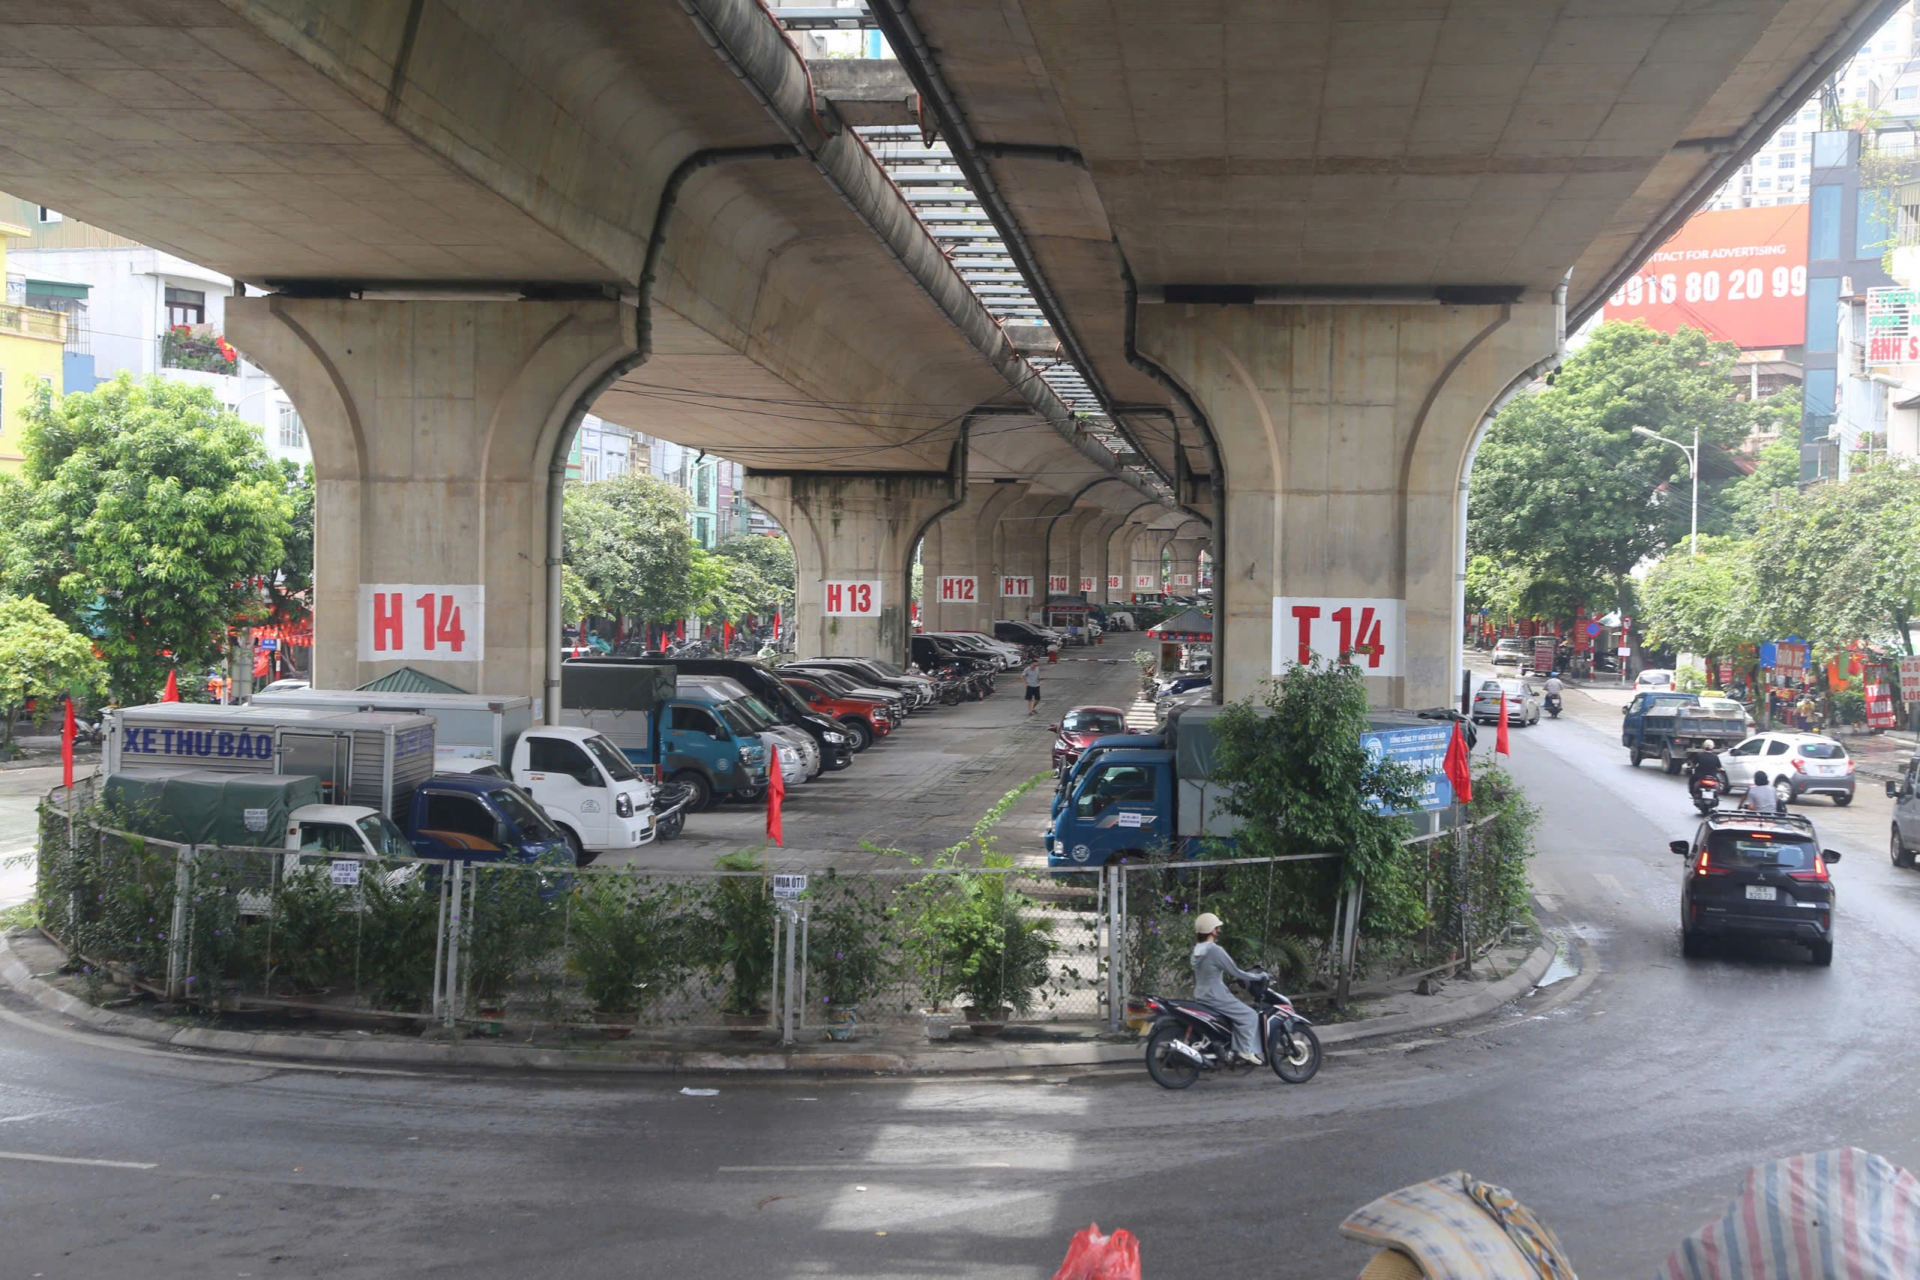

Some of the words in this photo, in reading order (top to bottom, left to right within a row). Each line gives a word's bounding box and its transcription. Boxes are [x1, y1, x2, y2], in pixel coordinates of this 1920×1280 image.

[1686, 249, 1710, 260] FOR
[1710, 244, 1787, 260] ADVERTISING
[1609, 273, 1678, 306] 0916
[1685, 270, 1720, 303] 80
[1727, 267, 1764, 300] 20
[1771, 265, 1807, 298] 99
[1139, 576, 1150, 586] H7
[123, 727, 158, 754] XE
[217, 726, 273, 760] BÁO
